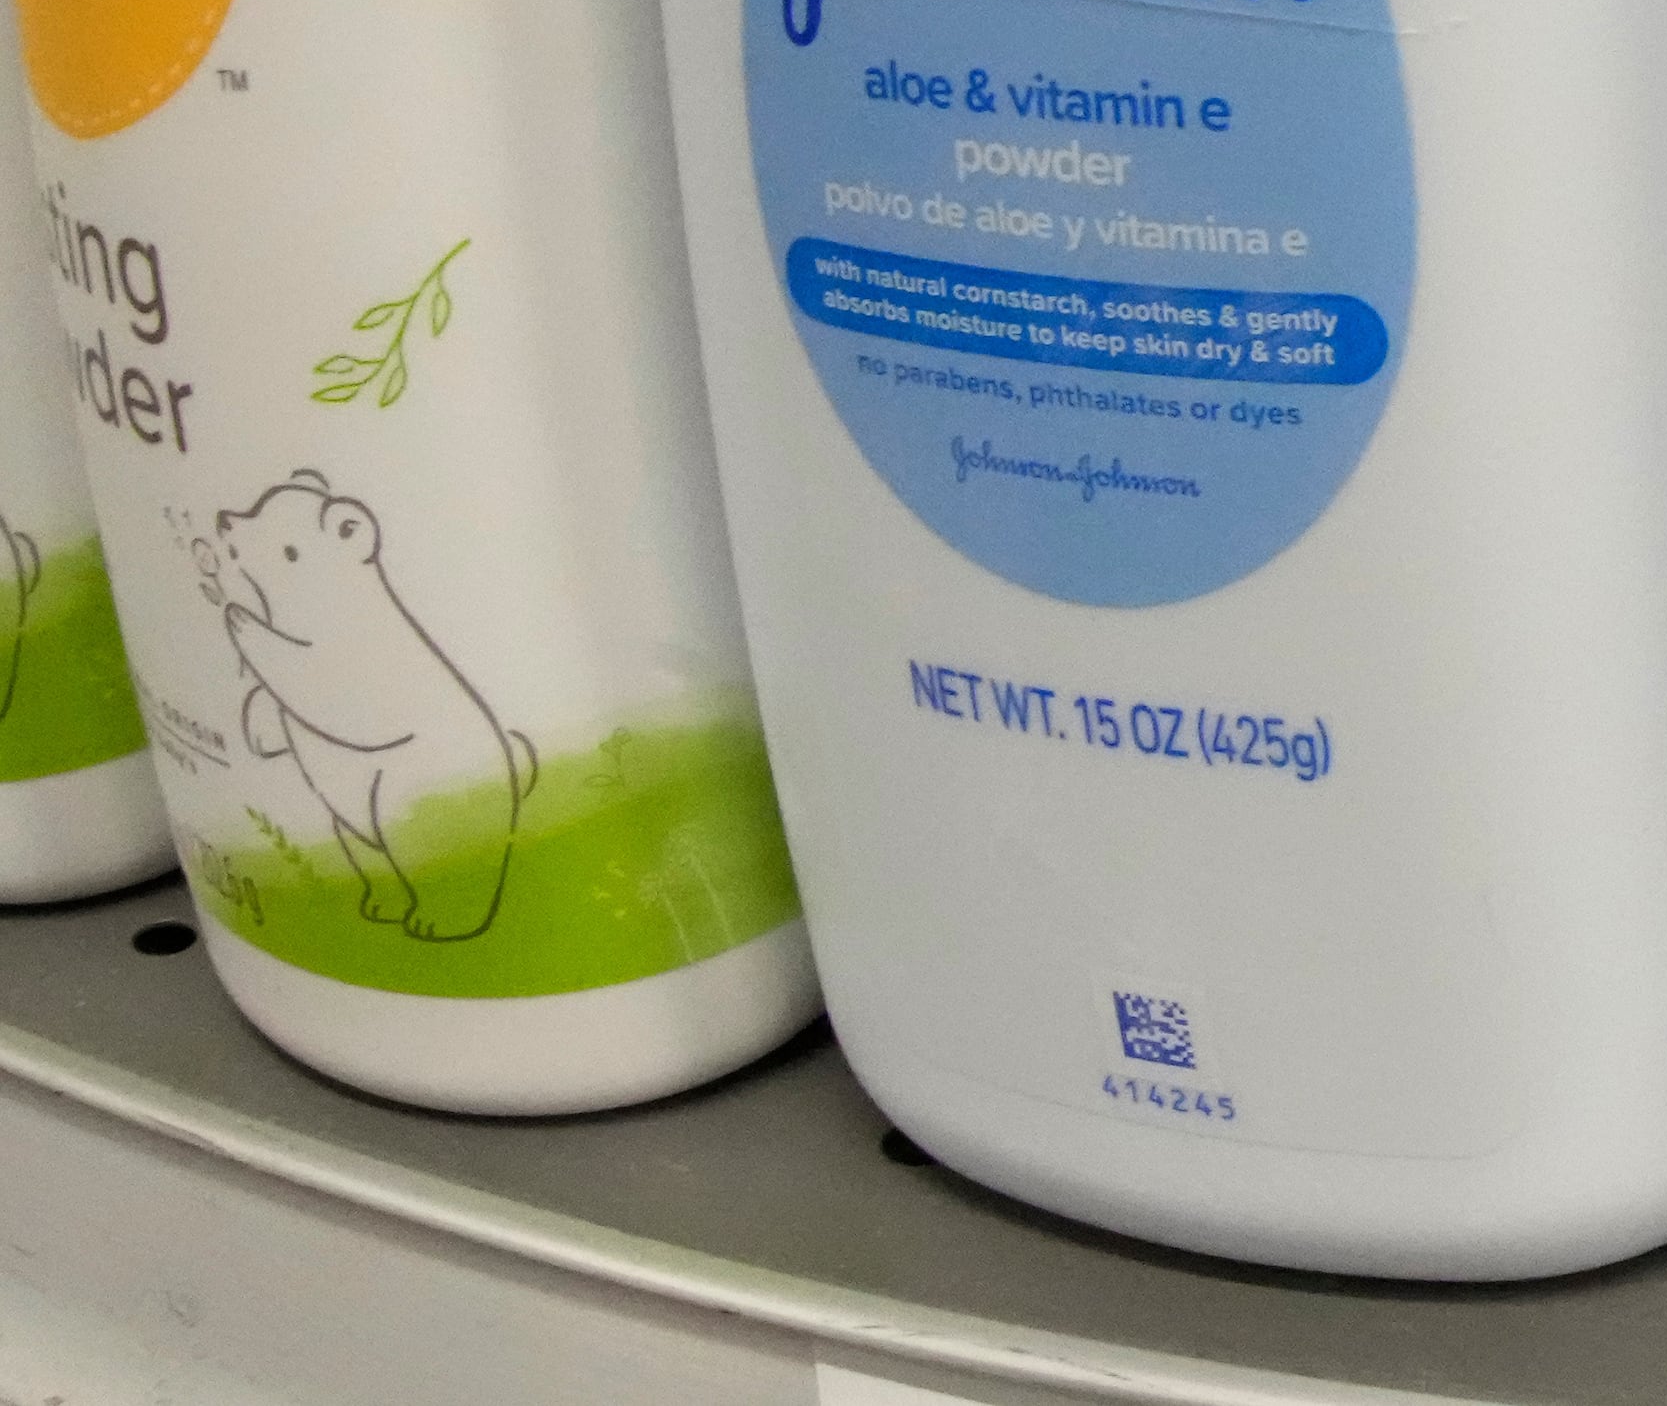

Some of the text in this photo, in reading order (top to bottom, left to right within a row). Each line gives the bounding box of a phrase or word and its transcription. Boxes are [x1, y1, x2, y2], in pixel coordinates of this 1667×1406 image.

[865, 60, 1231, 131] aloe & vitamin e
[955, 137, 1131, 186] powder
[825, 179, 1308, 256] polvo de aloe vitamina e
[48, 181, 168, 346] ting
[815, 253, 861, 283] with
[867, 266, 947, 299] natural
[1103, 299, 1212, 328] soothes
[1246, 307, 1338, 338] gently
[822, 287, 1335, 368] absorbs moisture keep skin dry soft
[76, 329, 193, 452] der
[1030, 373, 1180, 420] phthalates
[1231, 397, 1302, 430] dyes
[909, 660, 1330, 781] NET WT. 15 OZ (425g)
[1103, 1075, 1236, 1120] 414245
